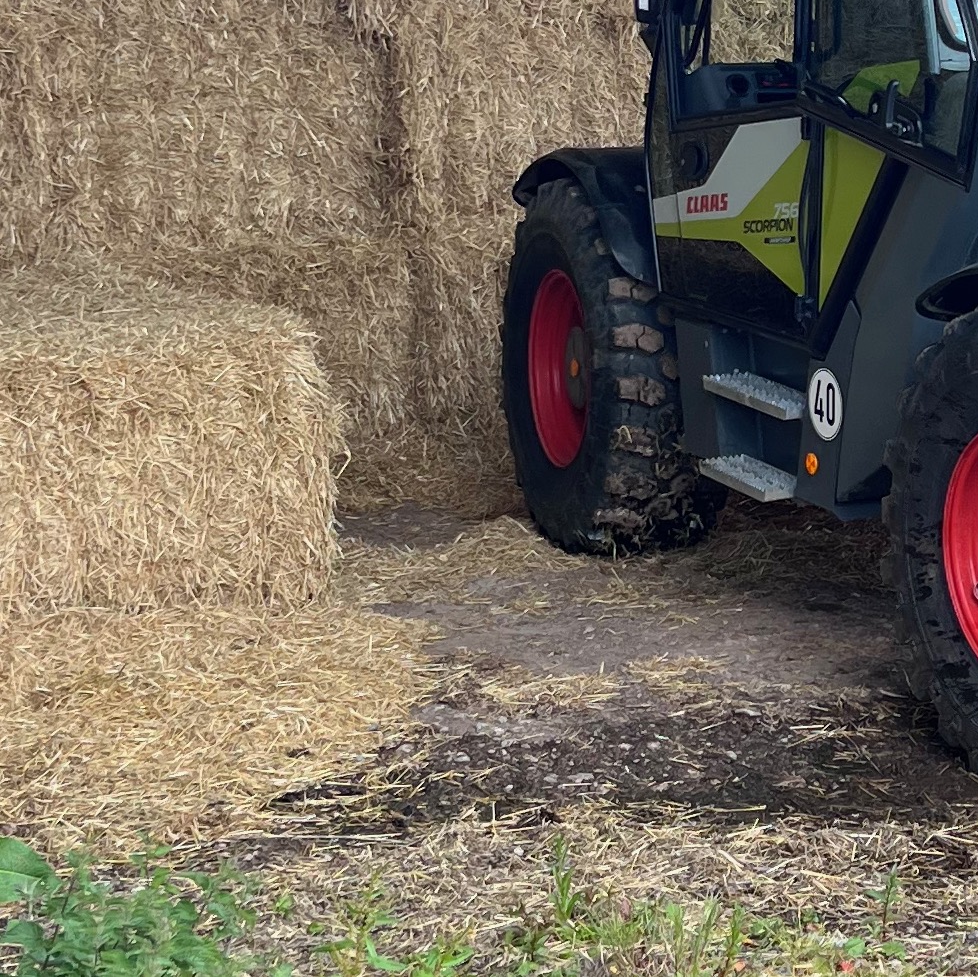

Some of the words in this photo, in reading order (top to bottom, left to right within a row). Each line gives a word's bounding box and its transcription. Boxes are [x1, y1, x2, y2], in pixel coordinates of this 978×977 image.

[686, 193, 729, 214] CLAAS
[774, 202, 799, 219] 756
[743, 218, 794, 234] SCORPION
[814, 379, 836, 427] 40
